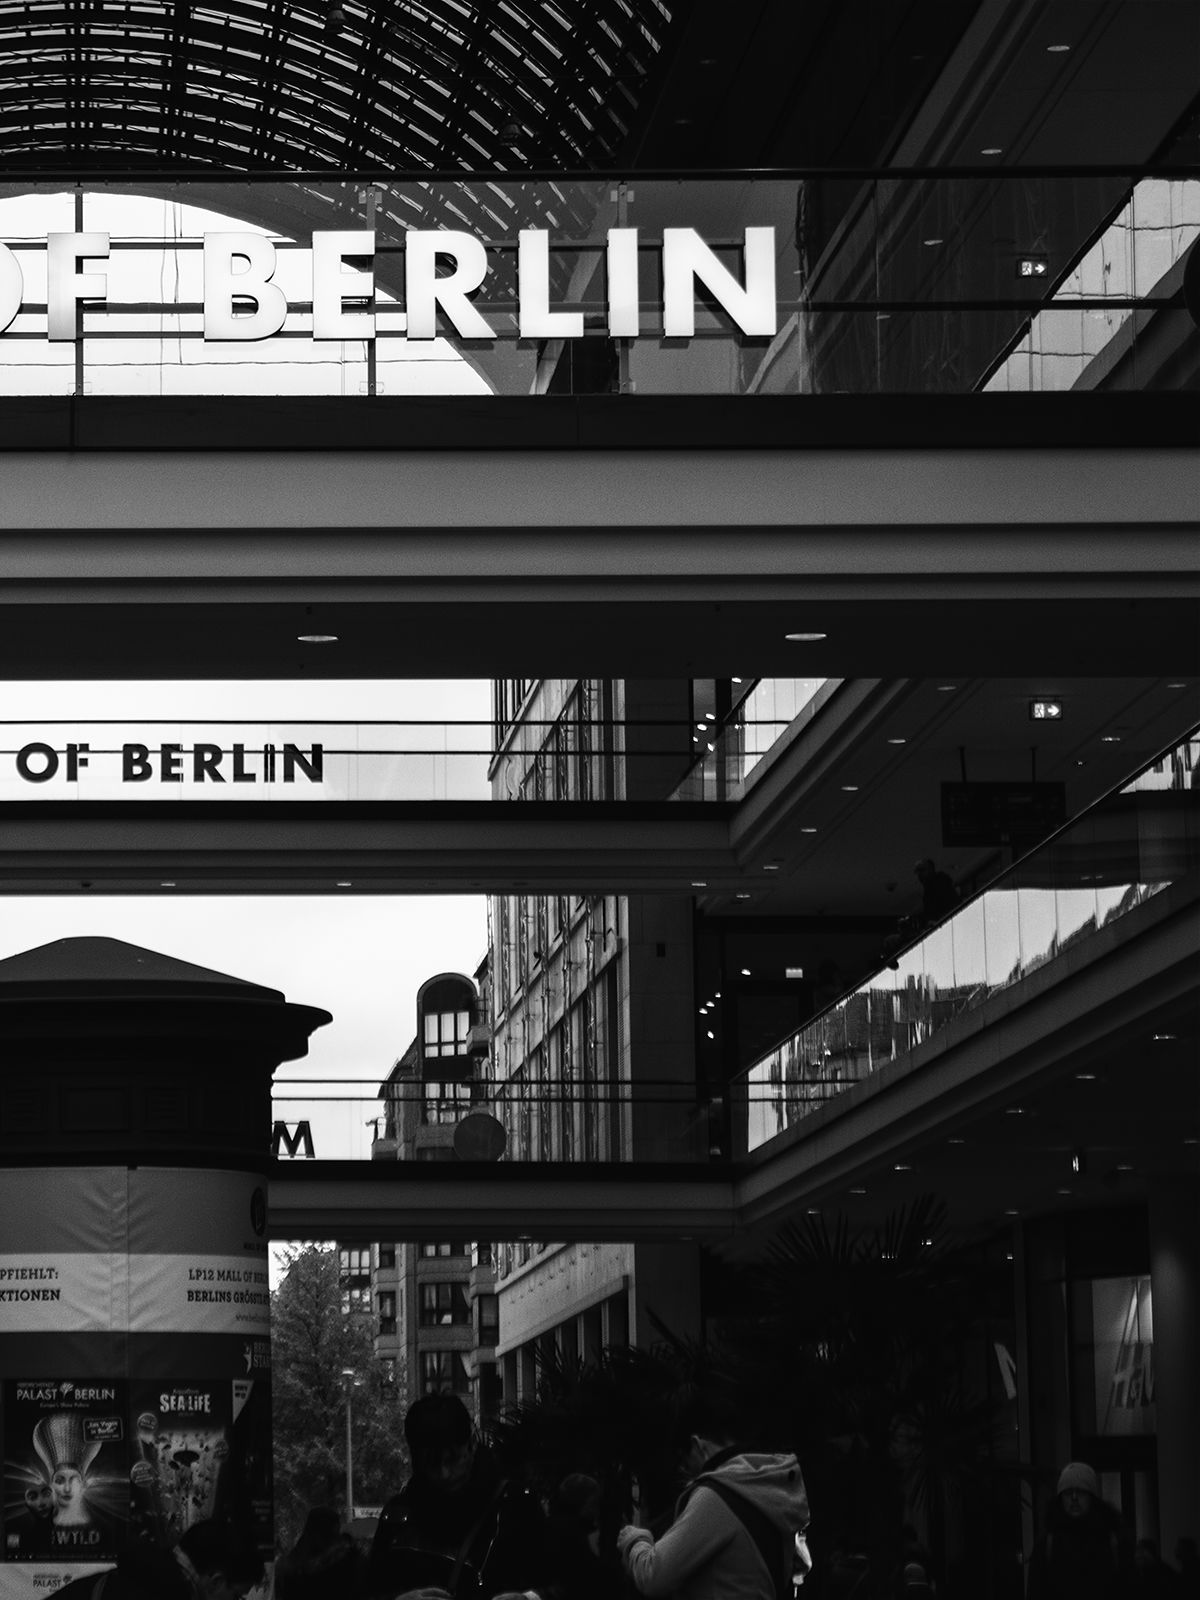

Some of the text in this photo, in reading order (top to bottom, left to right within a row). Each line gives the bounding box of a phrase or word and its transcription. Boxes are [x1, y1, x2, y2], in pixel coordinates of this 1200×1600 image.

[202, 225, 778, 343] BERLIN
[16, 741, 90, 784] OF
[122, 742, 324, 784] BERLIN
[188, 1269, 215, 1281] LP12
[216, 1270, 242, 1282] MALL
[243, 1271, 253, 1283] OF
[187, 1290, 231, 1303] BERLINS
[16, 1388, 115, 1401] PALAST BERLIN
[159, 1393, 185, 1413] SEA
[55, 1529, 99, 1545] WYLD
[32, 1579, 62, 1588] PALAST
